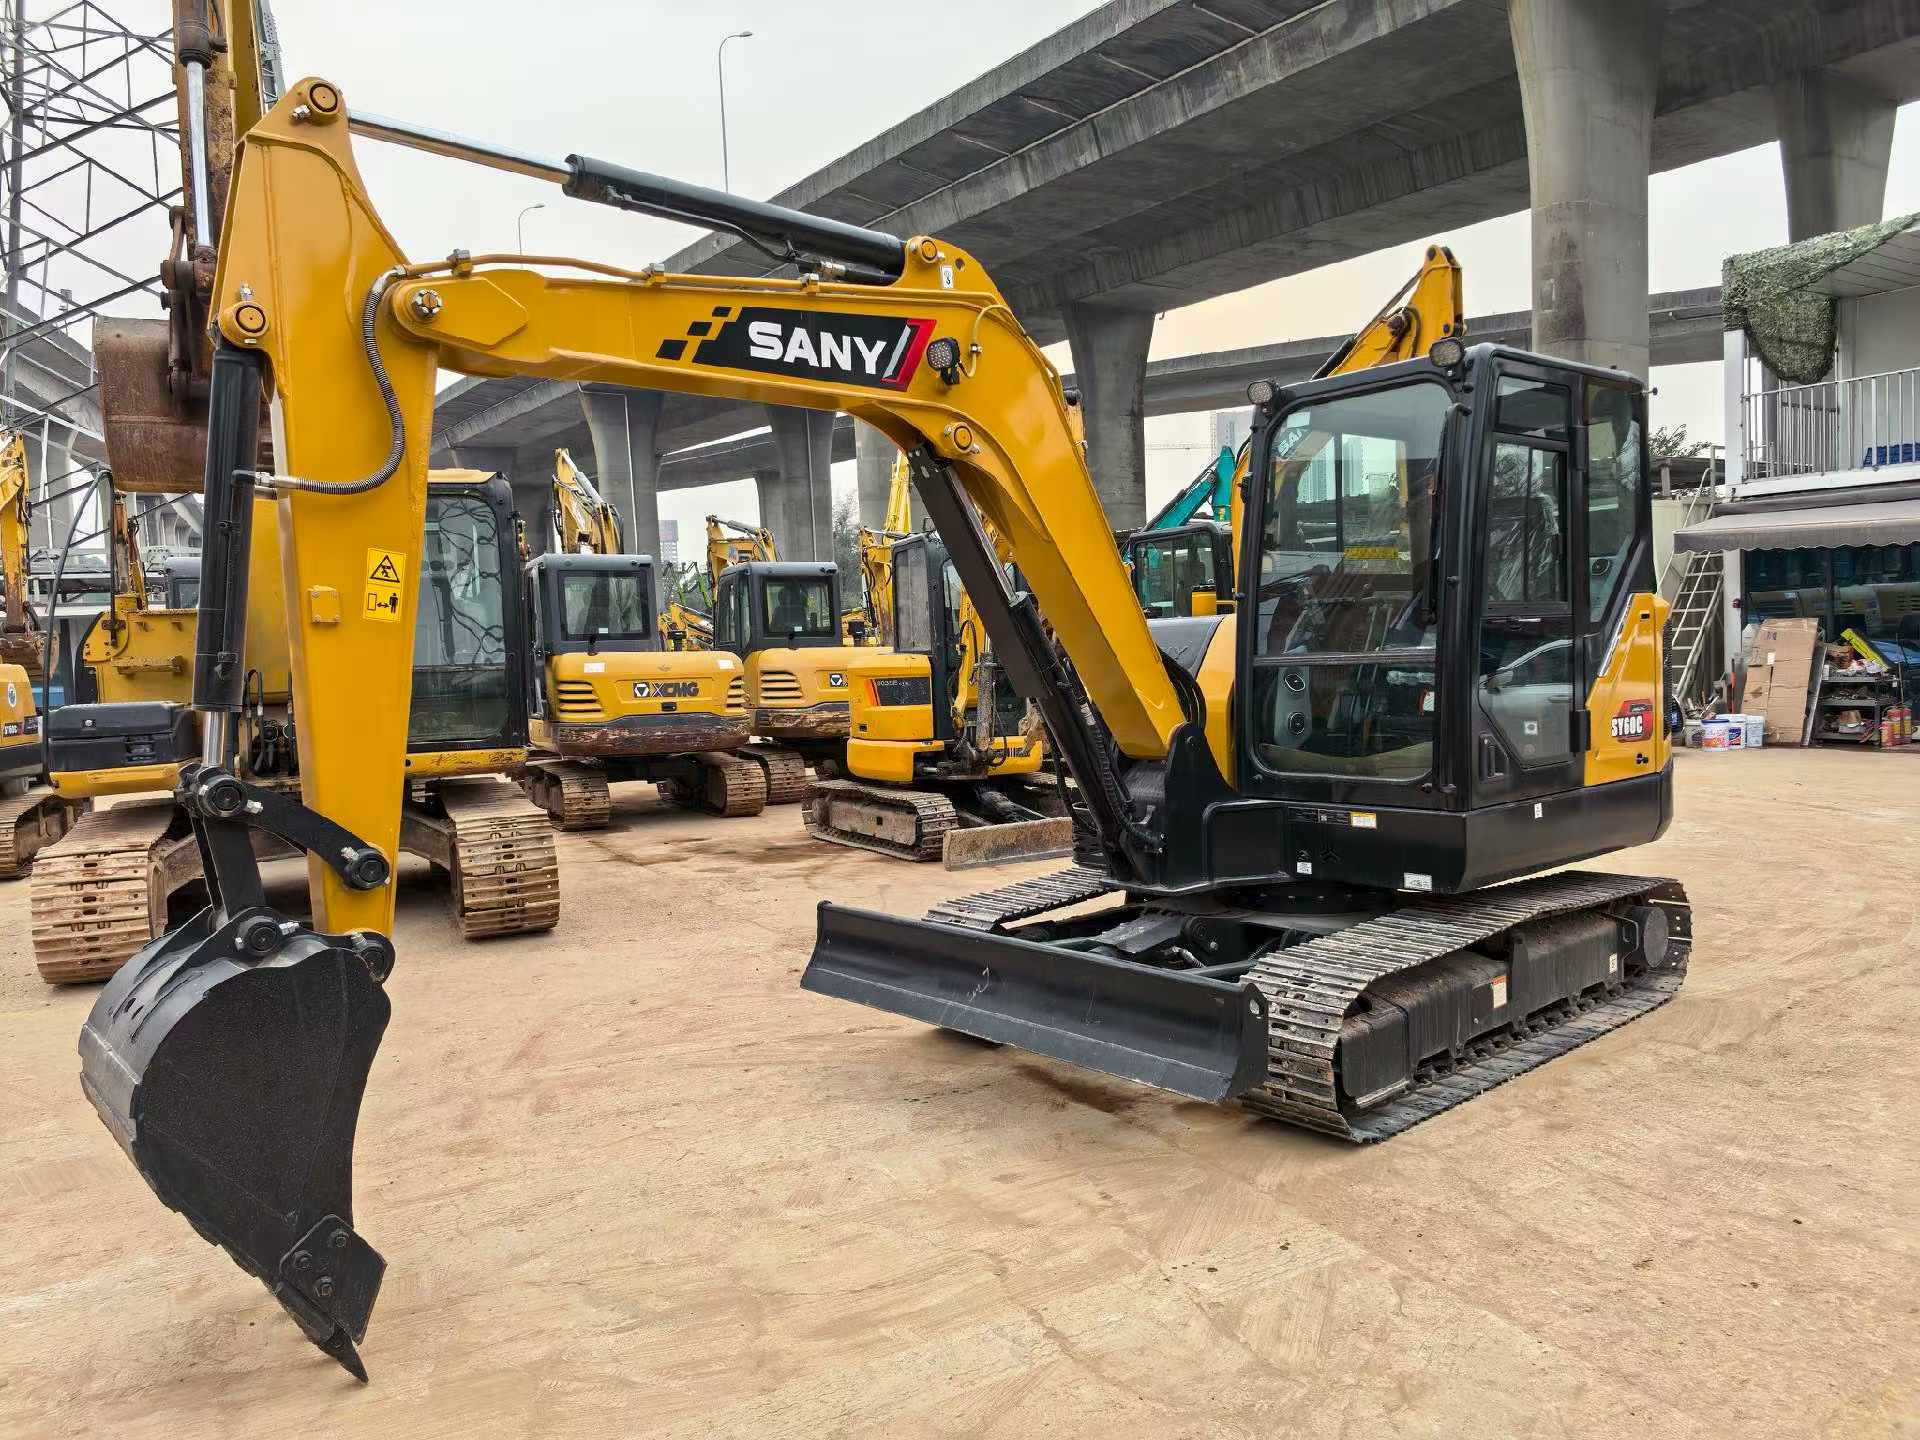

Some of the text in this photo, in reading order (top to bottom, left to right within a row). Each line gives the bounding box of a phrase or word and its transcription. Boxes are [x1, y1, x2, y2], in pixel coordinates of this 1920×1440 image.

[748, 320, 887, 375] SANY
[650, 682, 700, 698] XCMG
[1611, 715, 1643, 737] SY60C
